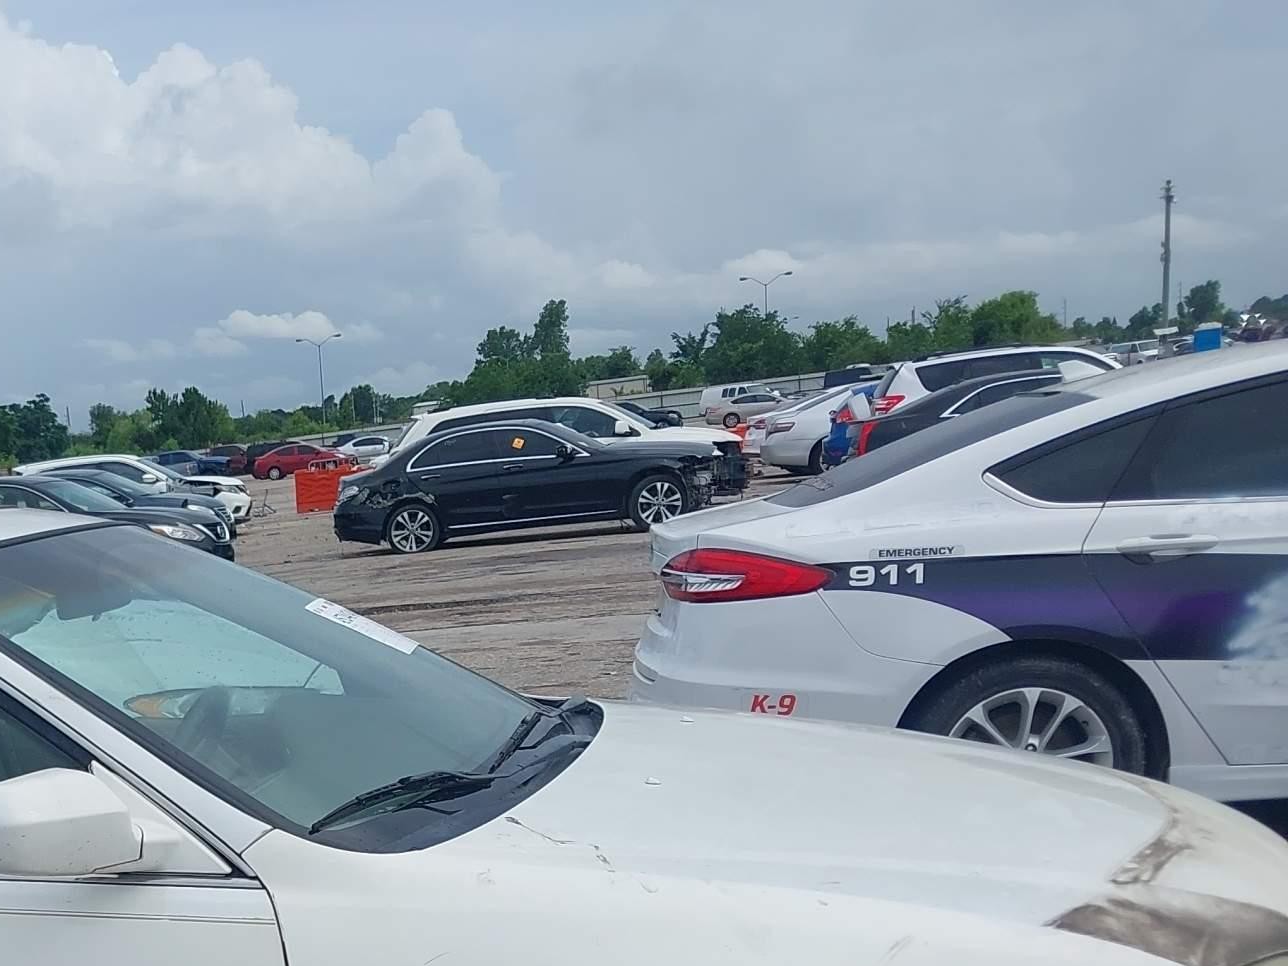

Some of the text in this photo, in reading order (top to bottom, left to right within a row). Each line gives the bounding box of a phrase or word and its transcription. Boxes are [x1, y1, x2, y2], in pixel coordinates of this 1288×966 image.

[878, 547, 955, 559] EMERGENCY
[848, 563, 924, 587] 911
[751, 693, 798, 716] K-9
